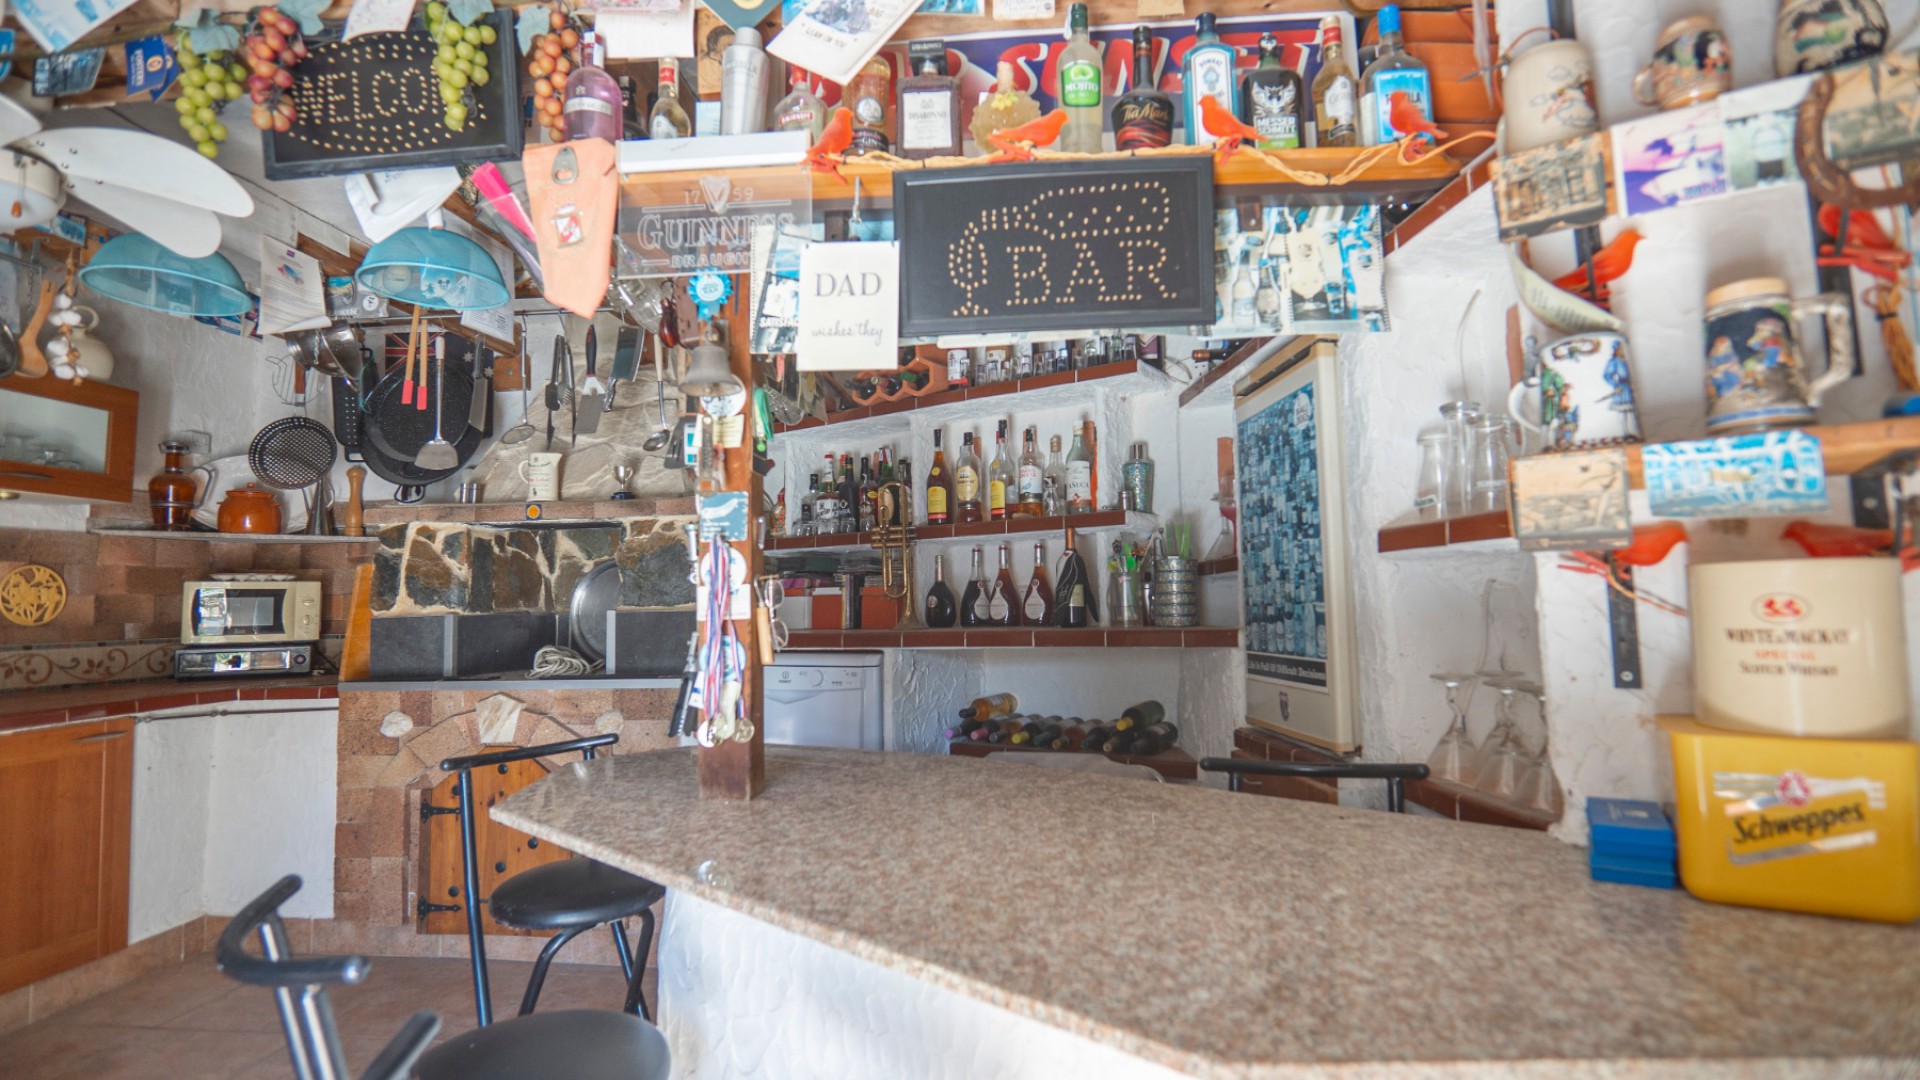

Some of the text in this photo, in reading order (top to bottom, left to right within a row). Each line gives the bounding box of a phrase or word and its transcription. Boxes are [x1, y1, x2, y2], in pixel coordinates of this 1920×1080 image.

[291, 66, 441, 125] WELCO
[1064, 82, 1100, 94] MOJITO
[1120, 104, 1141, 124] Tia
[1256, 117, 1296, 126] MESSER
[683, 187, 754, 205] 17 59
[671, 251, 751, 268] DRAUGH
[1004, 237, 1179, 307] BAR
[814, 271, 882, 297] DAD
[811, 319, 884, 347] wishes they
[1277, 663, 1297, 676] Difficult
[1298, 666, 1326, 680] Decisions
[1732, 803, 1865, 844] Schweppes
